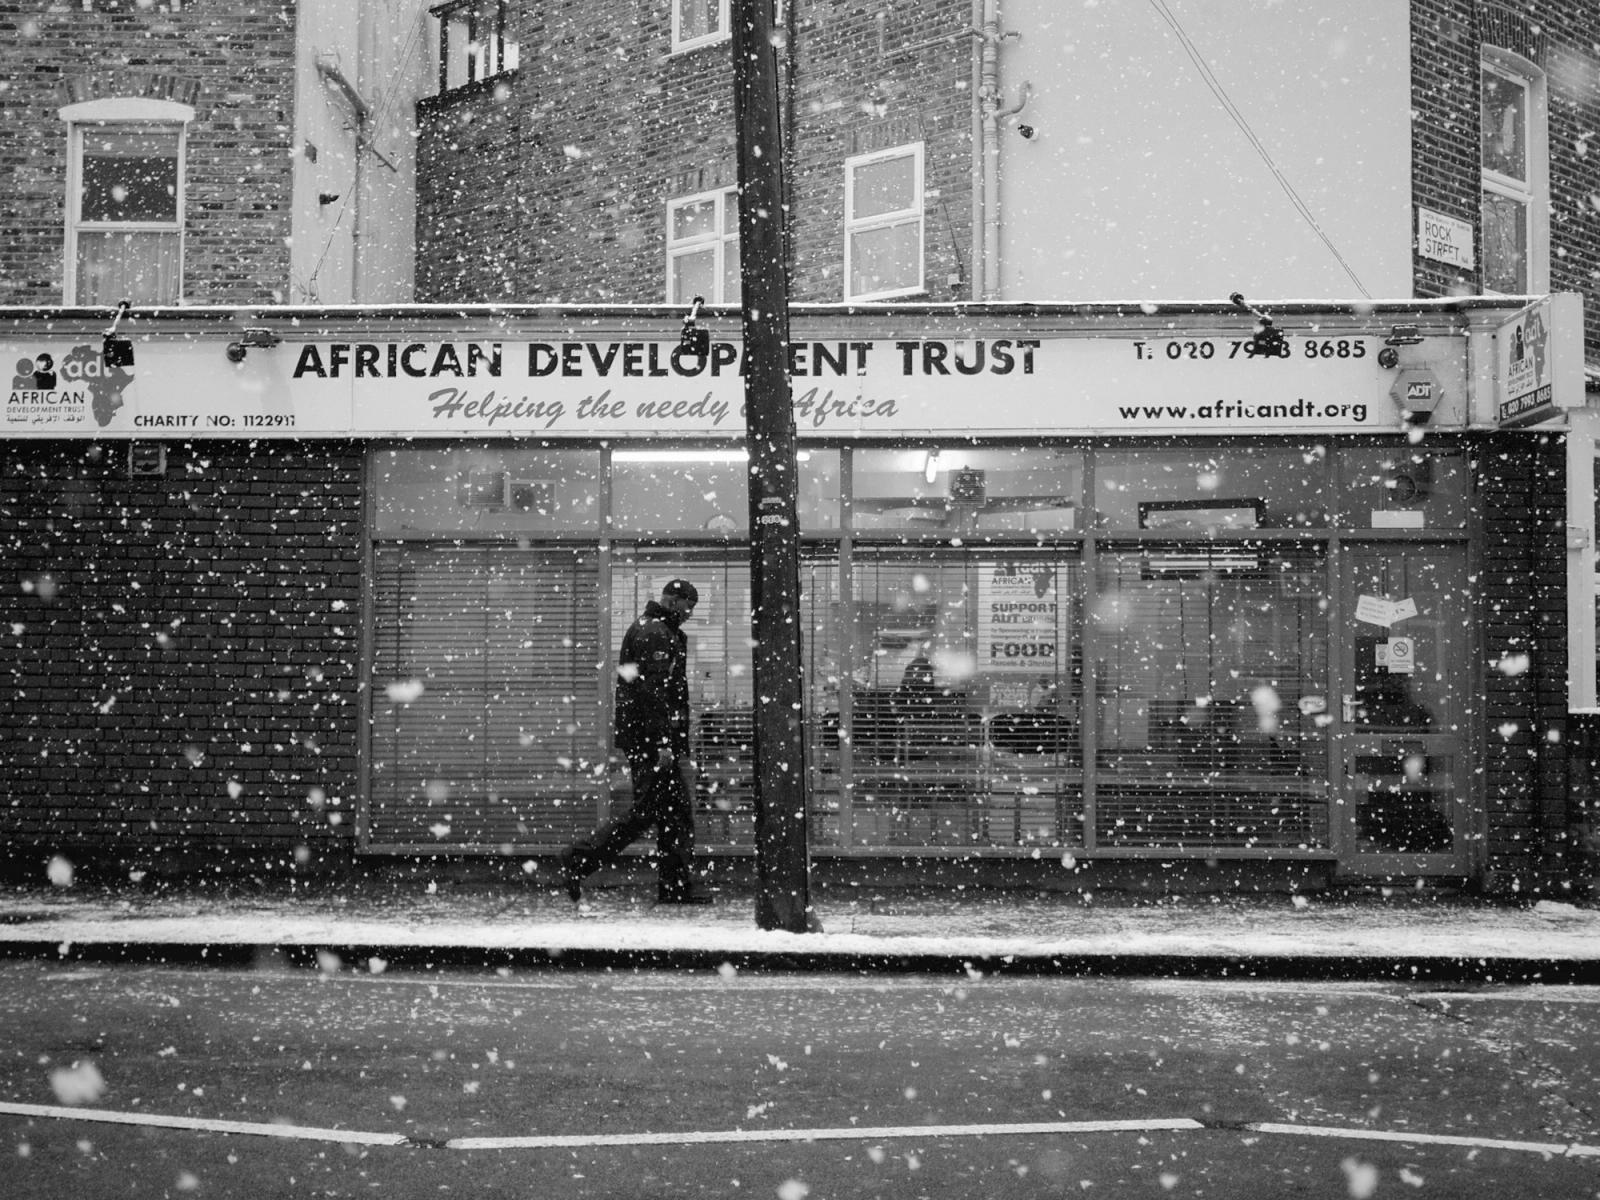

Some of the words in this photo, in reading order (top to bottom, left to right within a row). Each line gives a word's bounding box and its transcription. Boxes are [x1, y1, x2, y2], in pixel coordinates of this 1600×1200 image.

[1425, 221, 1452, 242] ROCK
[1425, 238, 1460, 261] STREET
[1166, 341, 1215, 360] 020
[1228, 340, 1292, 359] 793
[1304, 340, 1366, 359] 8685
[293, 343, 501, 378] AFRICAN
[528, 342, 873, 377] DEVELOPENT
[896, 340, 1041, 376] TRUST
[8, 391, 85, 405] AFRICAN
[1408, 384, 1432, 397] ADT
[6, 406, 62, 414] DEVELOPMENT
[428, 387, 566, 428] Helping
[576, 389, 627, 420] the
[636, 391, 730, 426] needy
[793, 386, 898, 427] Africa
[1119, 398, 1368, 422] www.africandt.org
[134, 415, 199, 427] CHARITY
[206, 415, 236, 427] NO:
[991, 603, 1057, 613] SUPPORT
[991, 642, 1055, 657] FOOD
